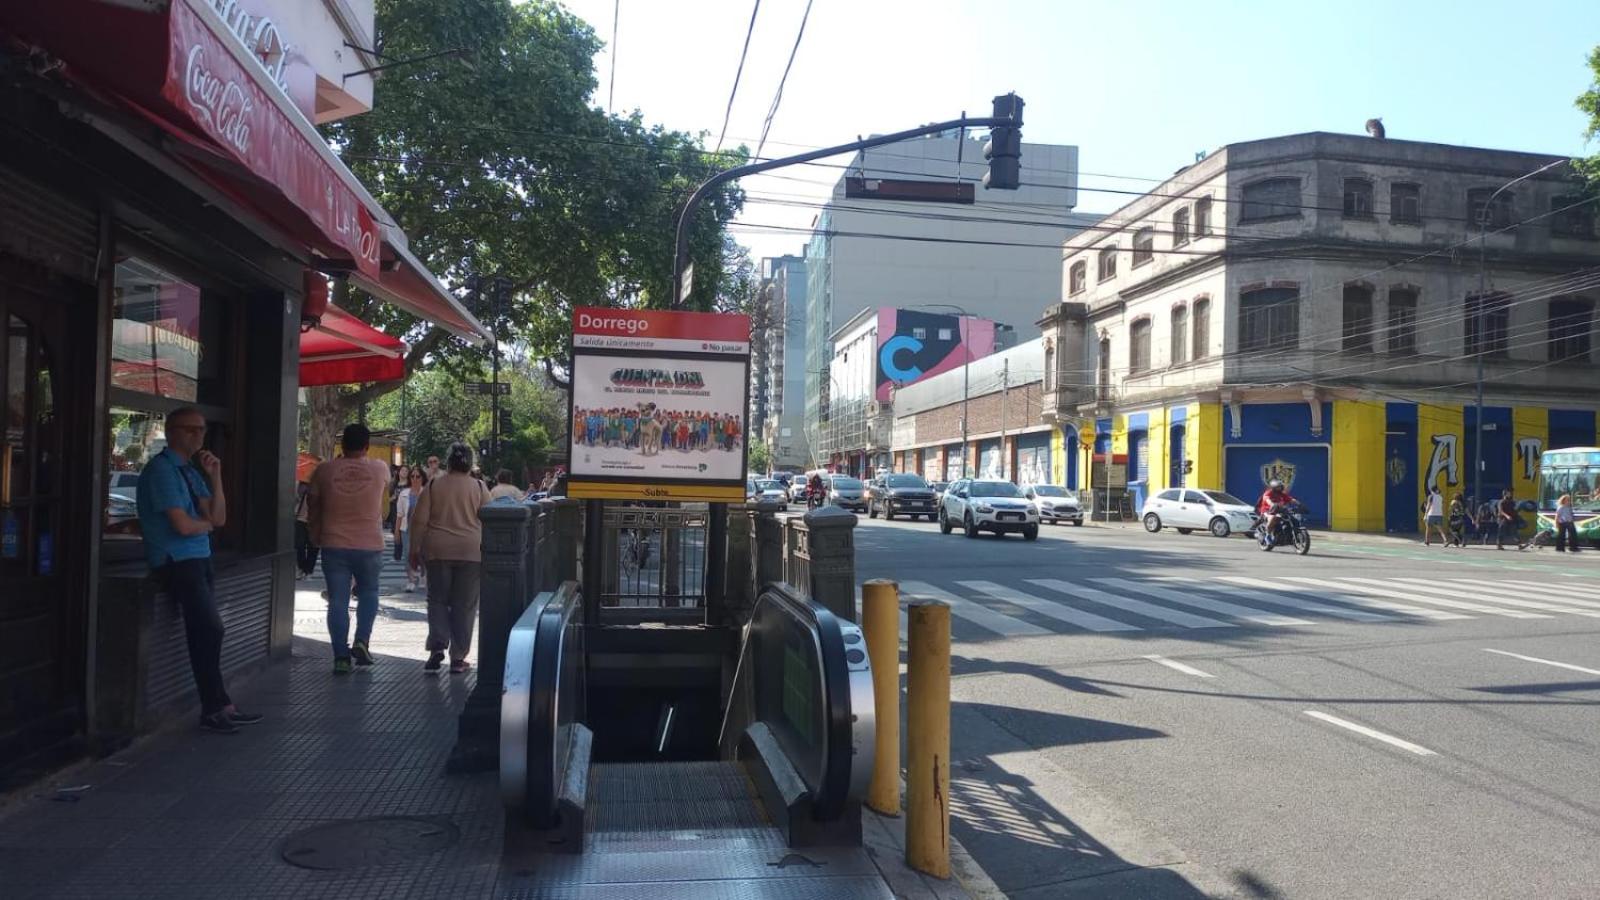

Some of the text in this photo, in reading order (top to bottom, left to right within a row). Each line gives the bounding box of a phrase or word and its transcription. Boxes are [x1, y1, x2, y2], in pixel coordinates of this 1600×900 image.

[579, 314, 649, 334] Dorrego
[580, 337, 655, 348] Salida únicamente
[709, 343, 743, 353] No pasar
[880, 335, 924, 384] C
[609, 368, 705, 390] CUENTA DNI
[1425, 434, 1458, 496] A
